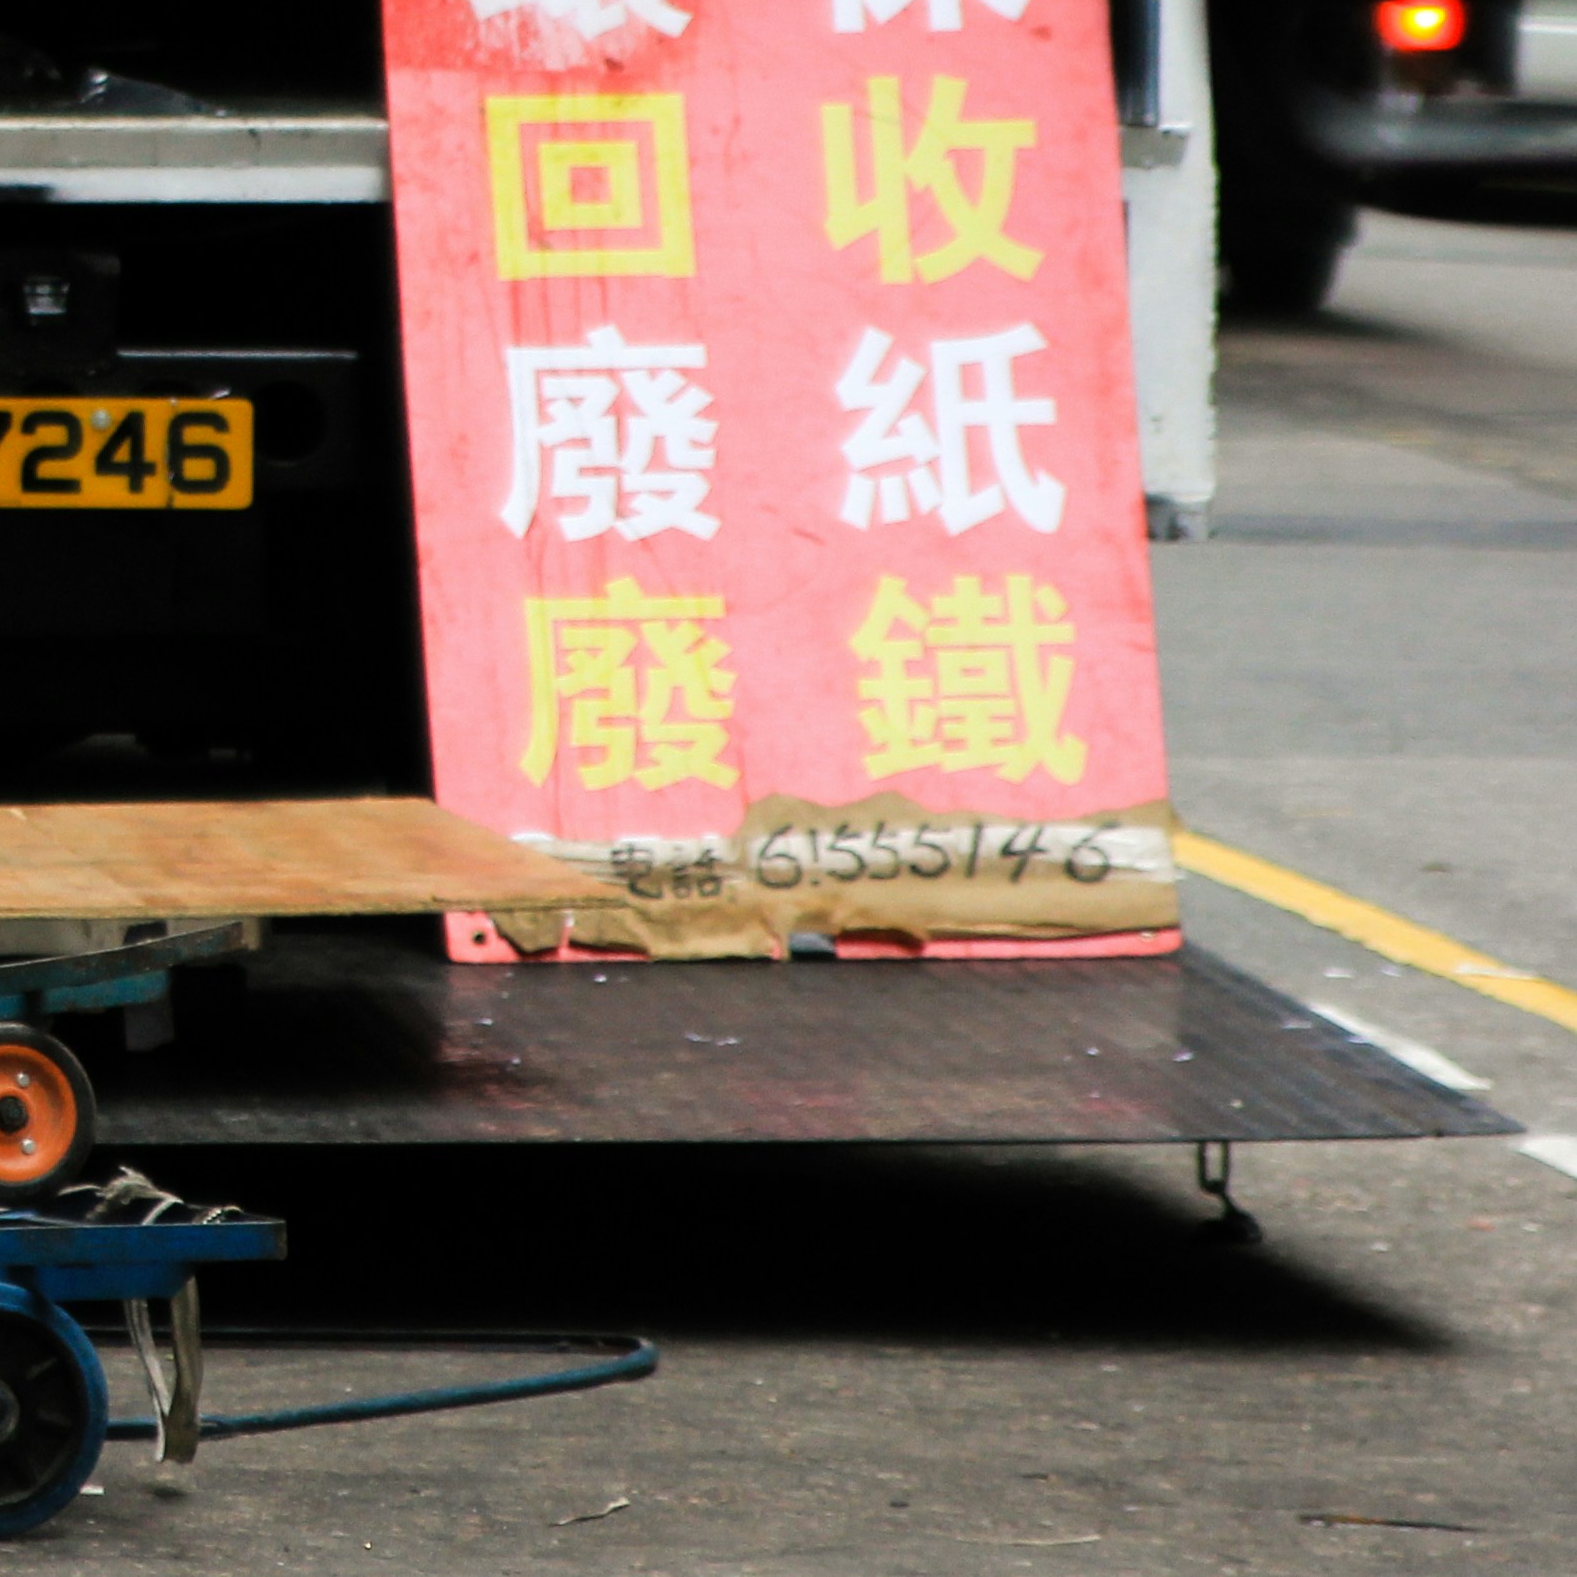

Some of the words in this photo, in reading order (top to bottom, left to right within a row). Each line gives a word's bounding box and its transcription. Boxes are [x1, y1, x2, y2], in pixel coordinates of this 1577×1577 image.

[485, 74, 1044, 286] 回收
[499, 324, 1068, 543] 廢紙
[518, 575, 1089, 792] 廢鐵
